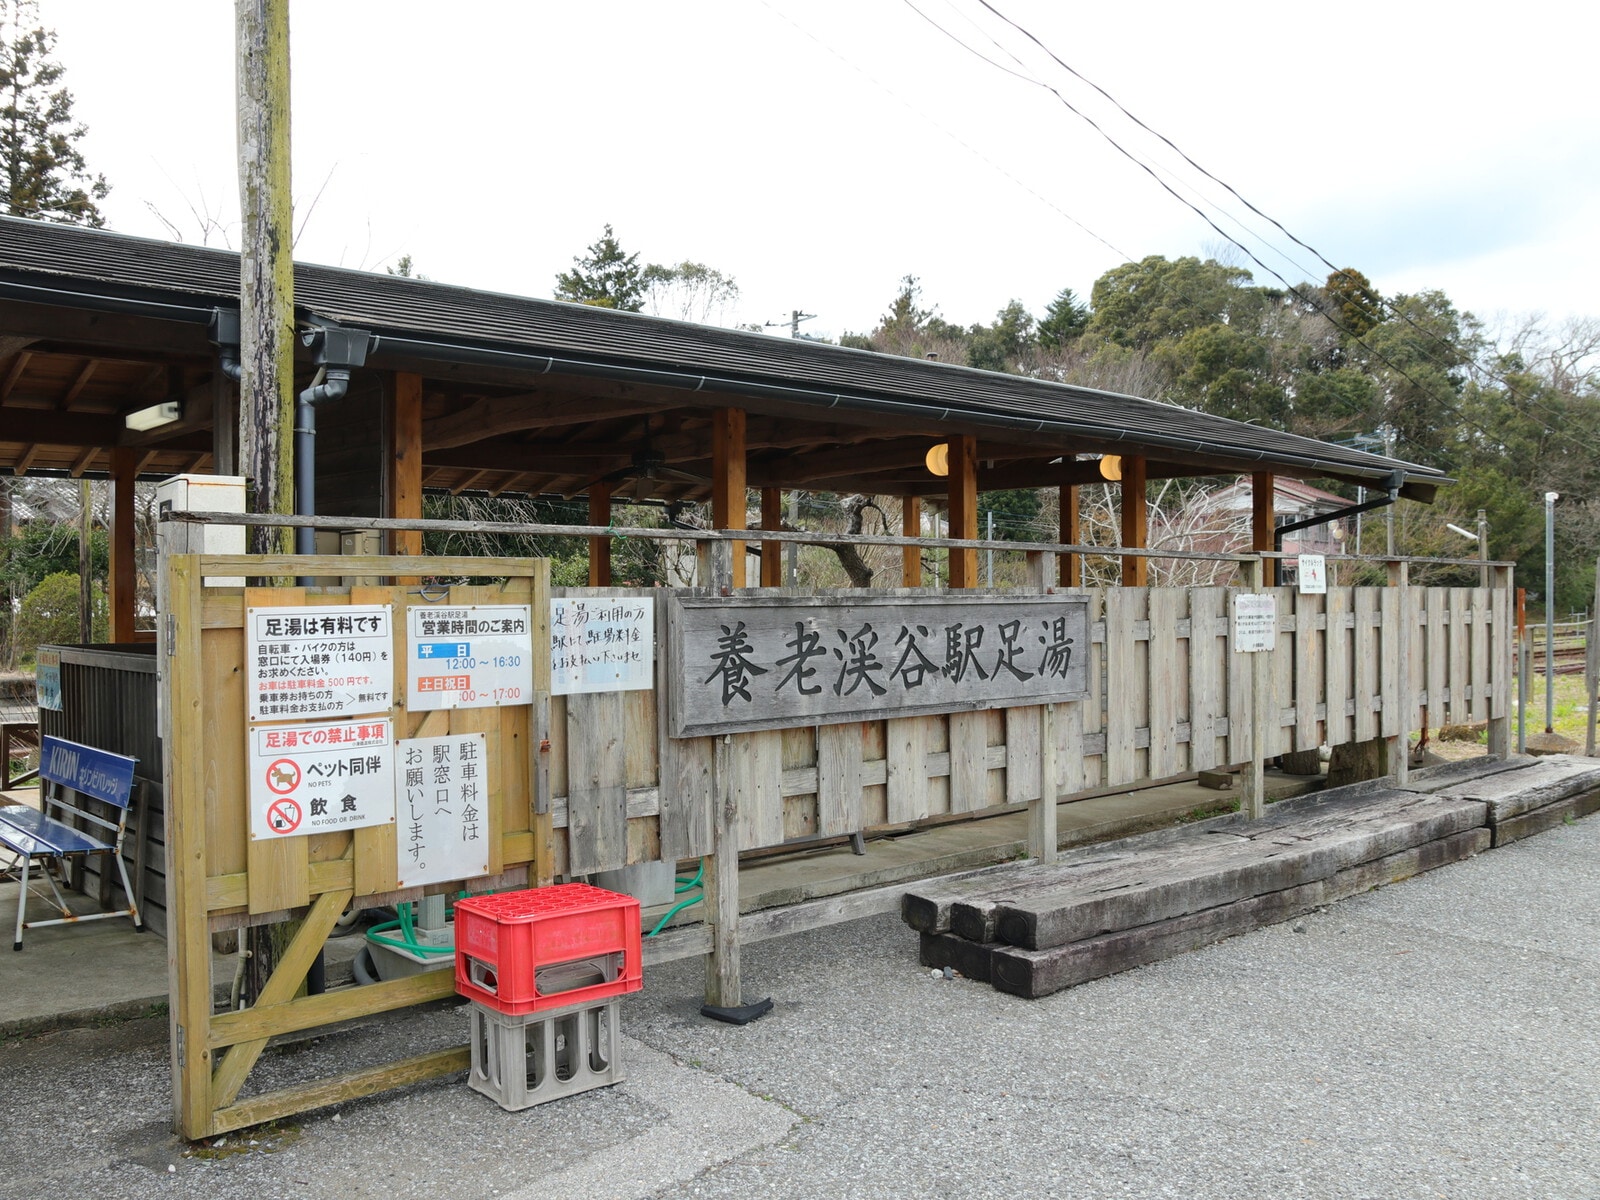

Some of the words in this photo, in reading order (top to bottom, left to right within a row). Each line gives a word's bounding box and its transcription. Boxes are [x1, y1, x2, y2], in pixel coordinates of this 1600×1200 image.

[420, 611, 468, 620] 養老渓谷駅足湯
[265, 616, 382, 636] 足湯は有料です
[422, 619, 524, 635] 営業時間のご案内
[258, 642, 355, 655] 自転車・バイクの方は
[421, 644, 466, 658] 平日
[258, 651, 388, 667] 窓口にて入場券（140円）を
[704, 616, 1074, 707] 養老渓谷駅足湯
[258, 667, 329, 679] お求めください。
[421, 678, 466, 691] 土日祝日
[259, 690, 333, 703] 乗車券お持ちの方
[259, 701, 343, 715] 駐車料金お支払の方
[358, 692, 388, 702] 無料です
[266, 724, 384, 748] 足湯での禁止事項
[49, 745, 80, 782] KIRIN
[307, 756, 381, 777] ペット同伴
[79, 766, 119, 795] キリンビバレッジ
[433, 745, 452, 815] 駅窓口へ
[459, 742, 479, 841] 駐車料金は
[310, 794, 357, 816] 飲食
[405, 748, 426, 869] お願いします。
[349, 814, 366, 822] DRINK
